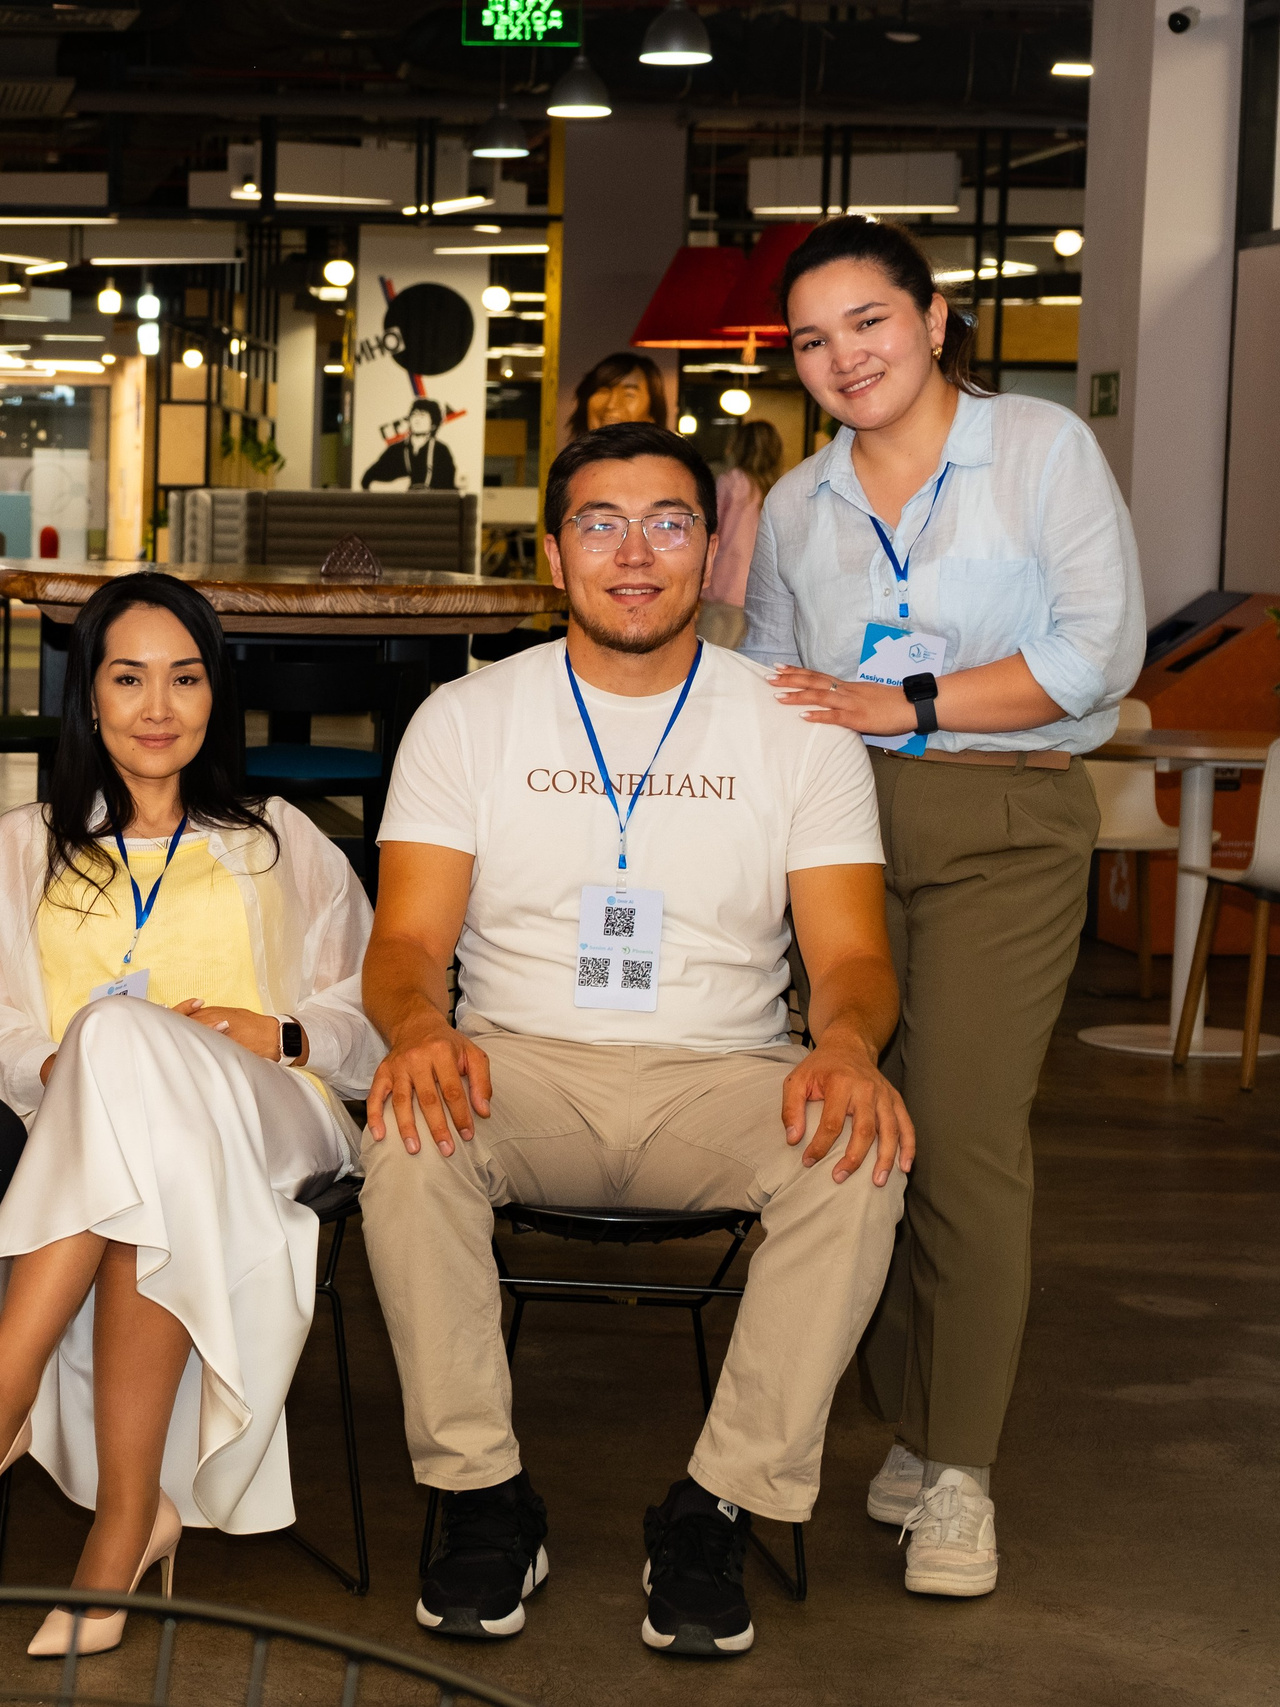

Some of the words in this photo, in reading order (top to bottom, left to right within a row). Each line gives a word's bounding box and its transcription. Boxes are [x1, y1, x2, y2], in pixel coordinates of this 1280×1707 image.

[482, 9, 563, 29] ВЫХОД
[494, 24, 547, 41] EXIT
[859, 672, 884, 683] Assiya
[527, 768, 737, 801] CORNELIANI
